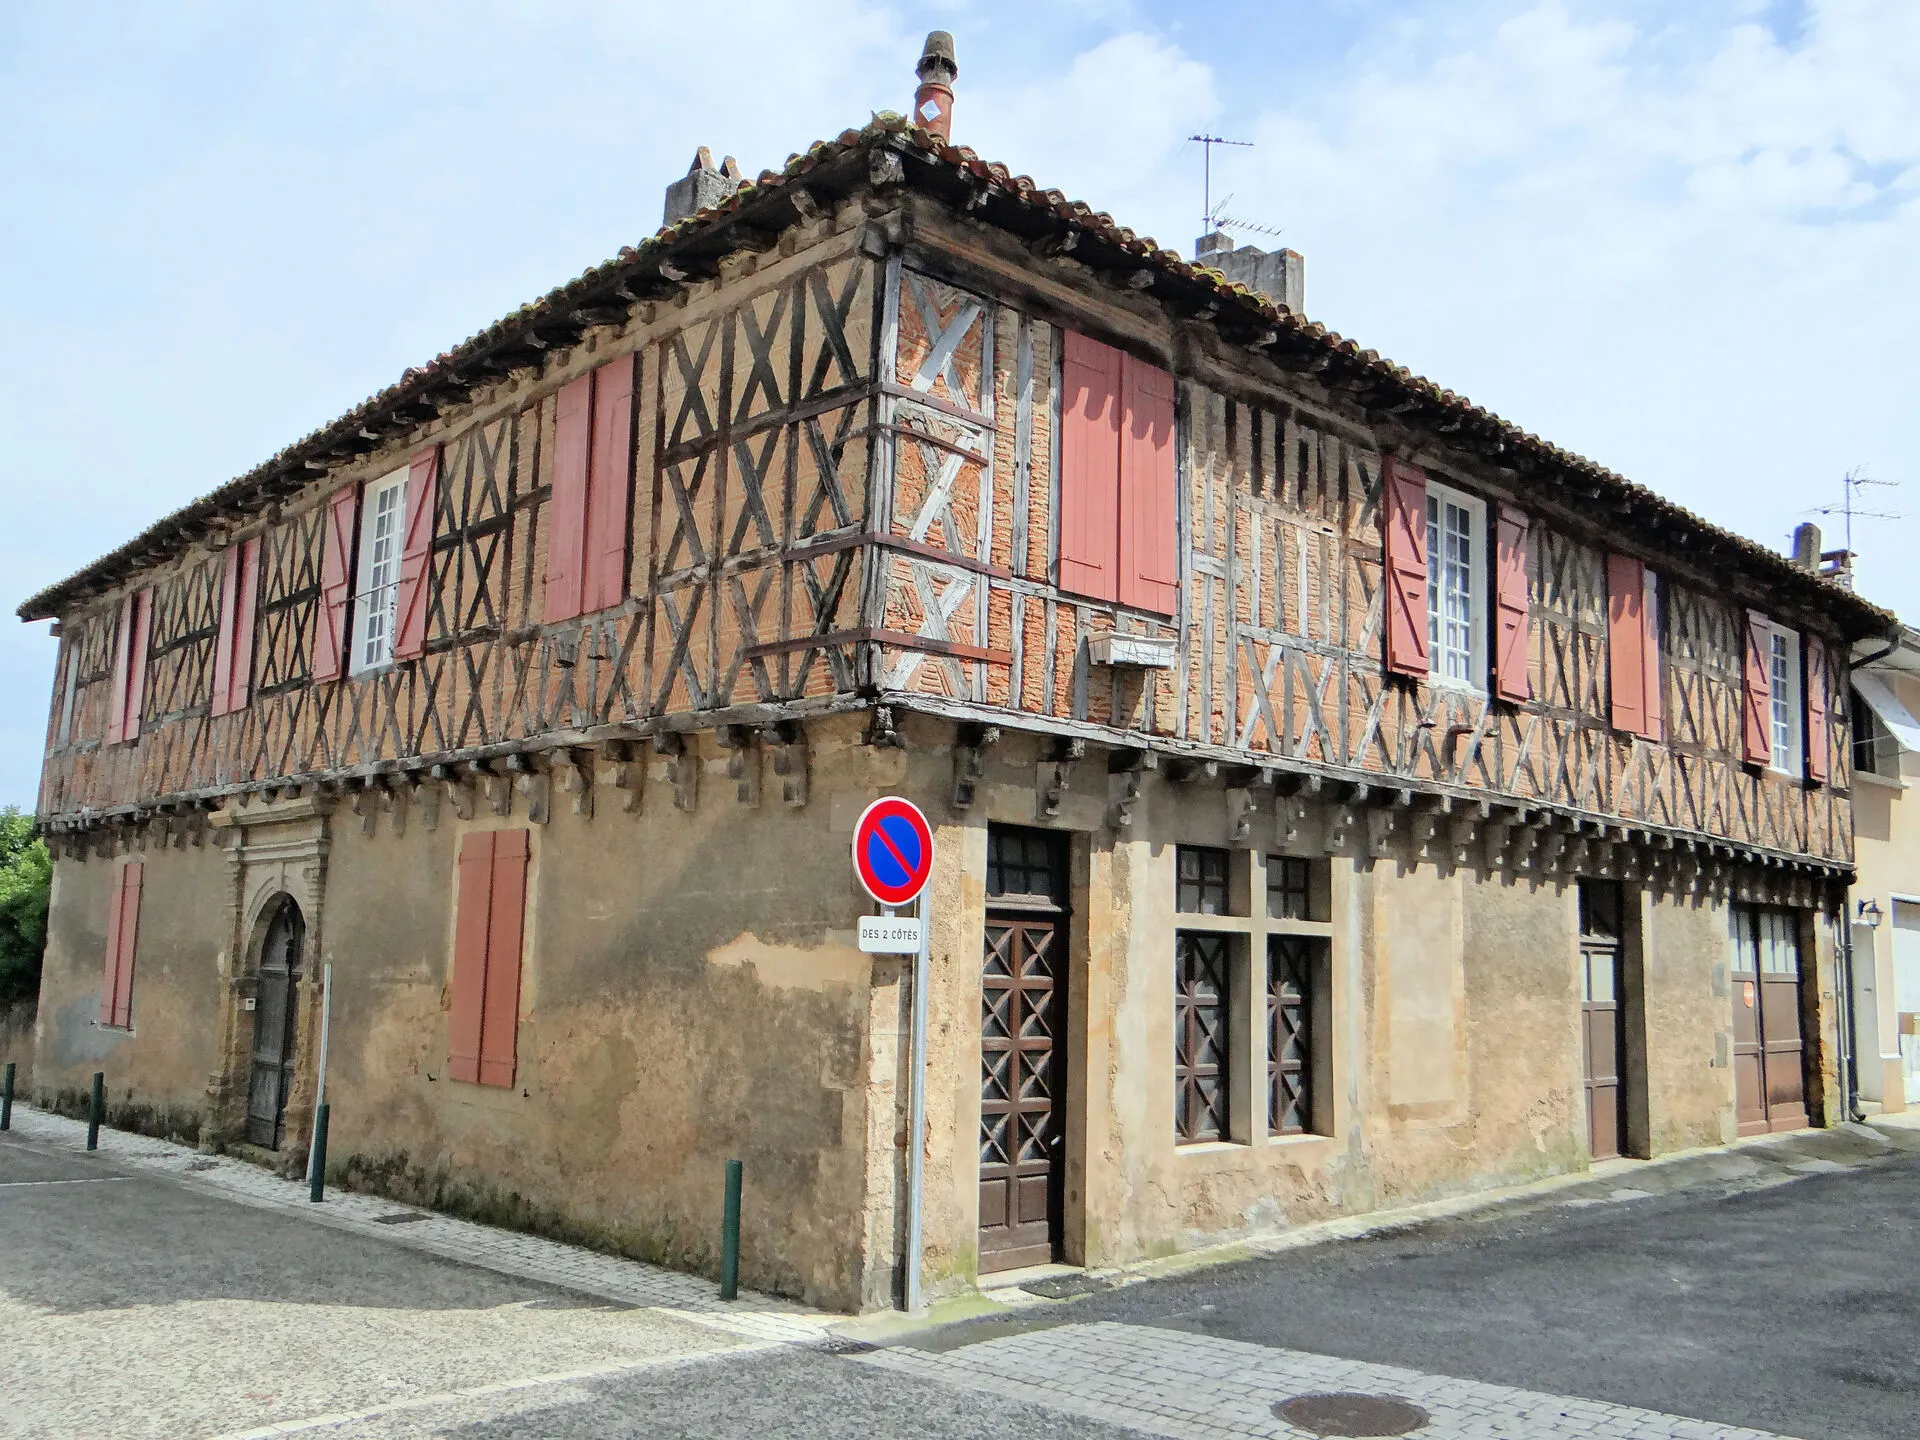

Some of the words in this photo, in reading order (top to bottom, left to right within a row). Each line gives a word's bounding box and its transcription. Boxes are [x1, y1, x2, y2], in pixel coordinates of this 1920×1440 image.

[862, 929, 879, 938] DES
[882, 930, 888, 939] 2
[892, 928, 918, 940] CÔTÉS
